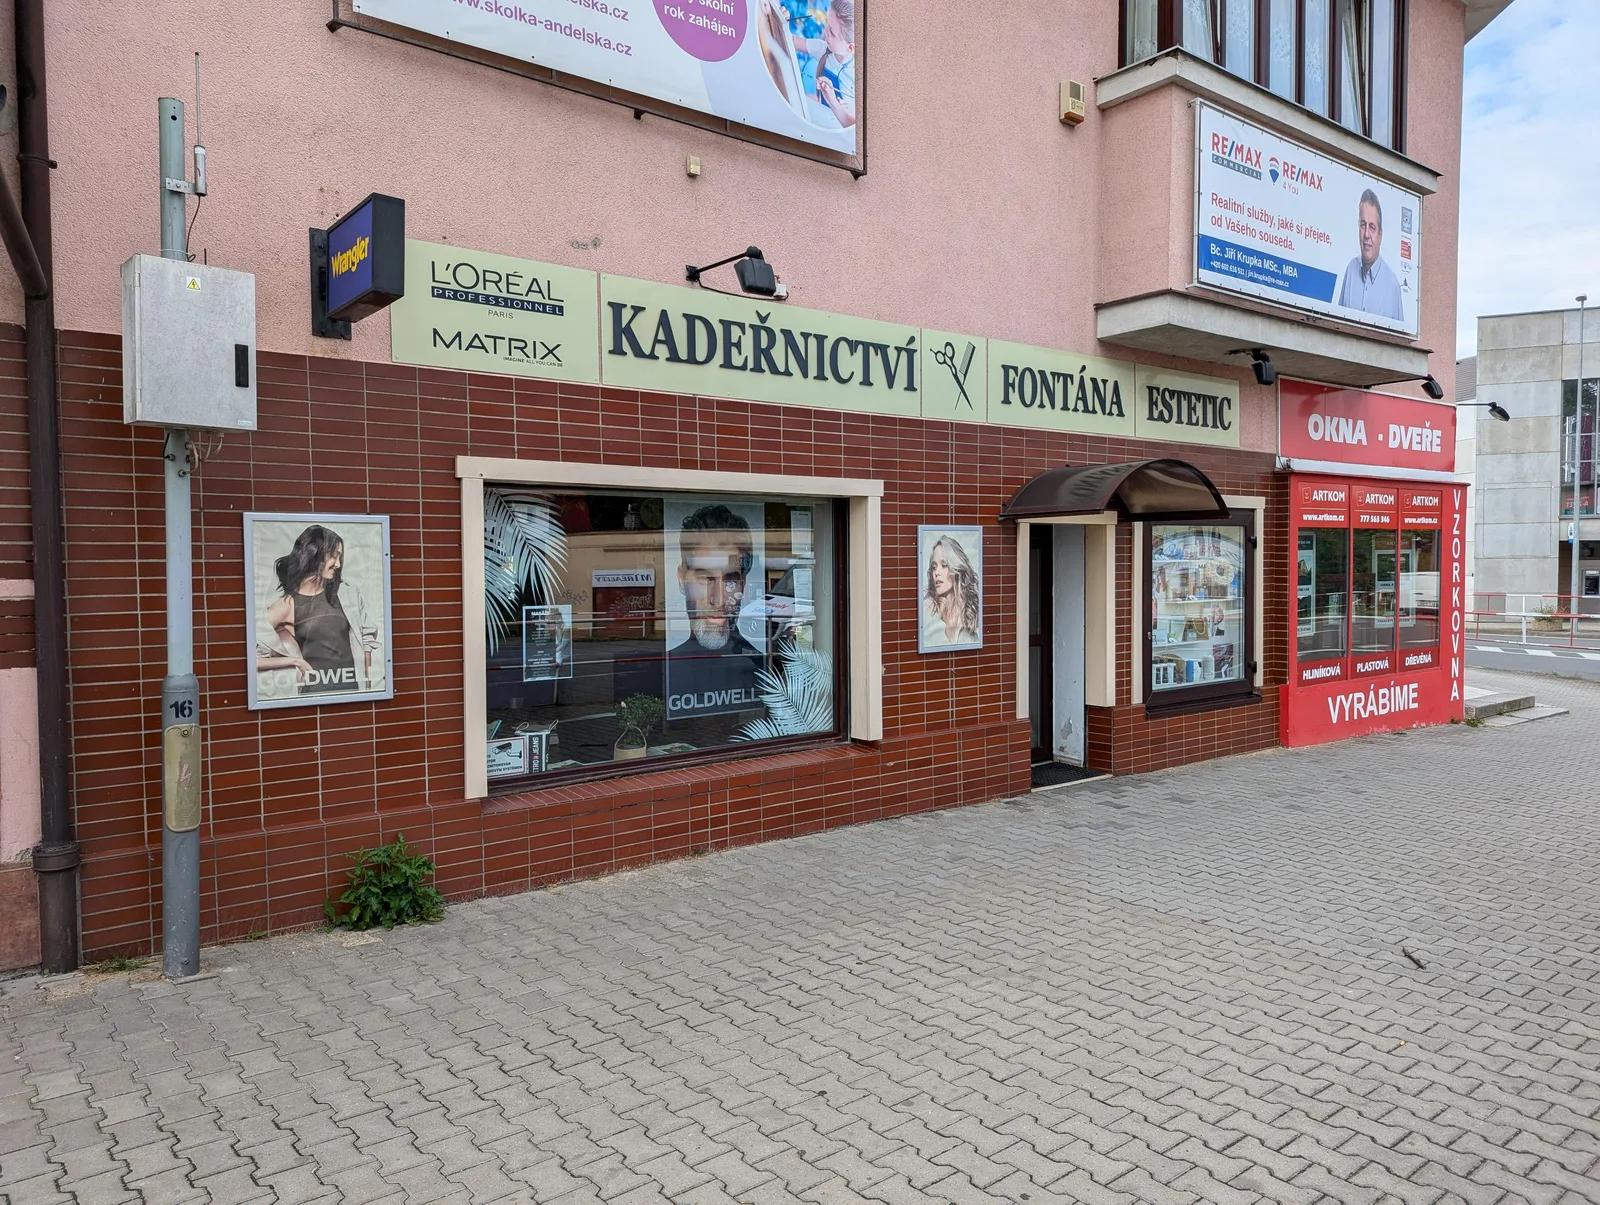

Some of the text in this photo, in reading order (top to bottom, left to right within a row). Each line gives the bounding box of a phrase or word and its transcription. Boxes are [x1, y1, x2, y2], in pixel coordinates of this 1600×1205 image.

[664, 4, 736, 38] rok zahájen
[1211, 132, 1262, 170] RE/MAX
[1212, 154, 1262, 180] COMMERCIAL
[1282, 161, 1323, 192] RE/MAX
[1211, 192, 1332, 248] Realitní služby, jaké si přejete,
[1211, 214, 1295, 251] od Vašeho souseda.
[331, 236, 370, 279] Wrangler
[1210, 242, 1298, 278] Bc. Jiří Krupka MSc., MBA
[432, 287, 564, 316] PROFESSIONNEL
[487, 308, 514, 320] PARIS
[432, 327, 563, 363] MATRIX
[607, 301, 918, 392] KADEŘNICTVÍ
[503, 356, 525, 364] IMAGINE
[1000, 364, 1126, 417] FONTÁNA
[1146, 385, 1232, 431] ESTETIC
[1308, 413, 1442, 453] OKNA DVEŘE
[1312, 490, 1345, 502] ARTKOM
[1365, 493, 1395, 505] ARTKOM
[1411, 495, 1439, 507] ARTKOM
[1302, 513, 1345, 521] www.artkom.cz
[1360, 514, 1369, 523] 777
[1404, 516, 1438, 524] www.artkom.cz
[1450, 488, 1461, 702] VZORKOVNA
[1303, 663, 1341, 680] HLINÍKOVÁ
[1356, 657, 1389, 673] PLASTOVÁ
[1405, 651, 1432, 666] DŘEVĚNÁ
[169, 700, 194, 719] 16
[668, 687, 761, 711] GOLDWELL
[1327, 681, 1419, 724] VYRÁBÍME
[532, 736, 540, 755] JEANS
